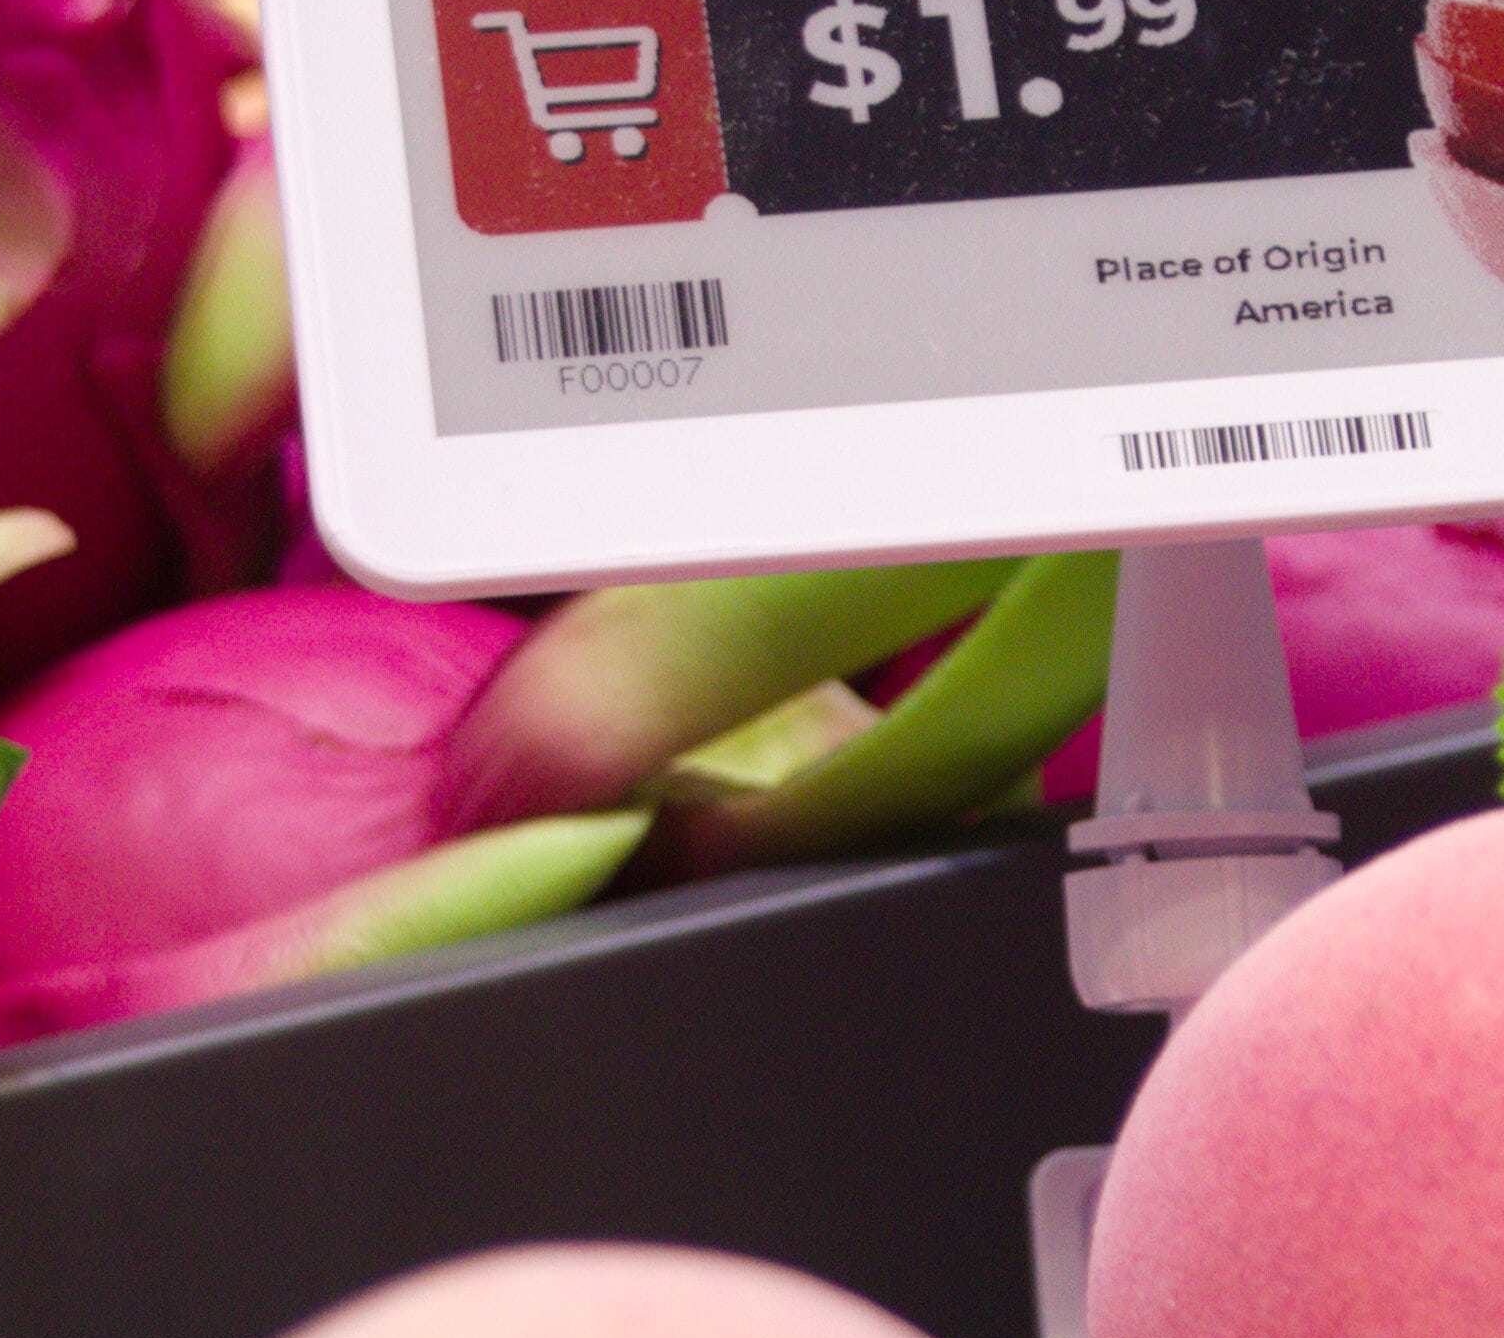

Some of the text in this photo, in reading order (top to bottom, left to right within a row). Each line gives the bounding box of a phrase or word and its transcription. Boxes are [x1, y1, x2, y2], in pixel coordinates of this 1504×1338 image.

[1096, 238, 1386, 283] Place of Origin
[1234, 290, 1395, 325] America
[559, 356, 704, 394] F00007
